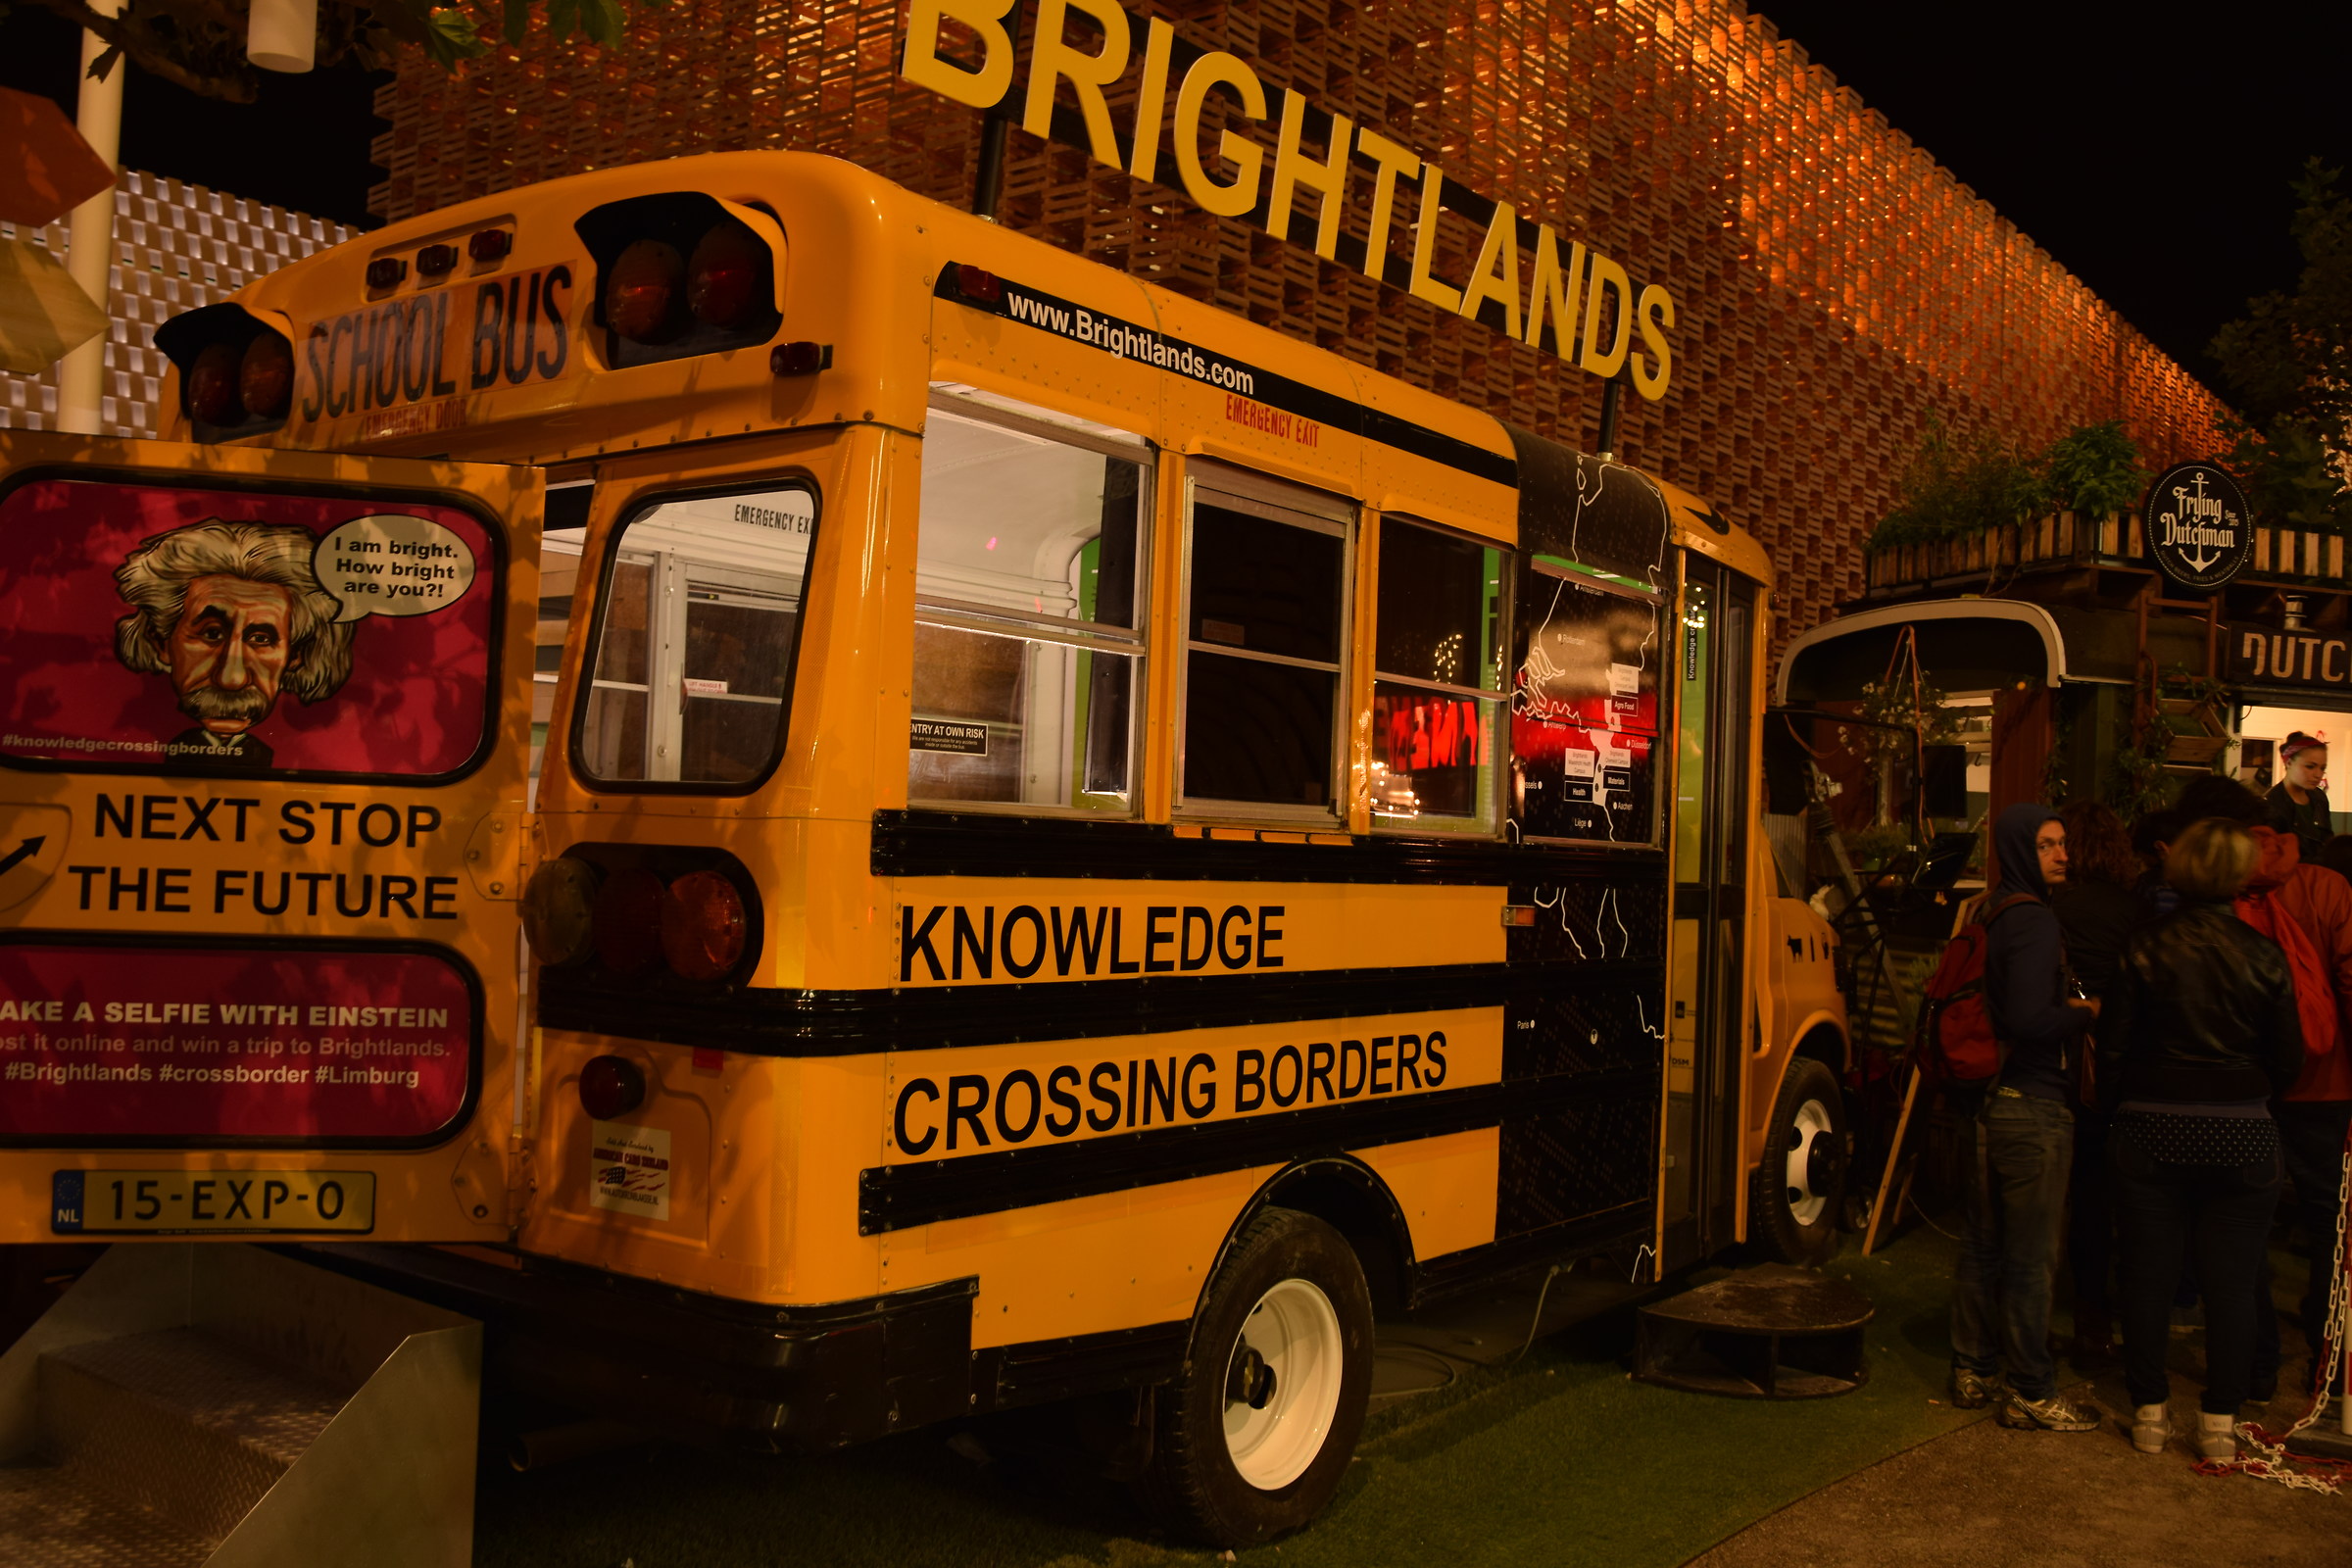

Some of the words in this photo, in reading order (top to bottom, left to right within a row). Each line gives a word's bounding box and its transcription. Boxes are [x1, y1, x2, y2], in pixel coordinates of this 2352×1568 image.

[902, 0, 1675, 401] BRIGHTLANDS
[302, 291, 456, 422] SCHOOL
[471, 265, 571, 389] BUS
[1007, 291, 1253, 396] www.Brightlands.com
[367, 404, 430, 441] EMERGENCY
[436, 398, 467, 429] DOOR
[1226, 394, 1290, 439] EMERGENCY
[1296, 421, 1319, 448] EXIT
[735, 504, 795, 531] EMERGENCY
[2173, 486, 2223, 525] Frying
[335, 536, 342, 551] I
[349, 540, 381, 553] am
[389, 540, 459, 560] bright.
[2160, 512, 2235, 549] Dutchman
[336, 558, 384, 574] How
[391, 562, 455, 581] bright
[344, 581, 379, 594] are
[386, 583, 444, 599] you?!
[1688, 637, 1697, 680] Knowledge
[2242, 632, 2352, 683] DUTC
[2, 734, 243, 757] #knowledgecrossingborders
[909, 722, 933, 735] NTRY
[934, 725, 945, 737] AT
[946, 725, 964, 738] OWN
[965, 727, 985, 740] RISK
[1524, 781, 1538, 790] ssels
[95, 794, 260, 842] NEXT
[278, 801, 442, 848] STOP
[69, 865, 190, 912] THE
[215, 870, 458, 919] FUTURE
[900, 906, 1285, 982] KNOWLEDGE
[0, 1001, 63, 1022] AKE
[73, 1002, 95, 1022] A
[104, 1003, 211, 1024] SELFIE
[220, 1004, 298, 1025] WITH
[309, 1005, 448, 1027] EINSTEIN
[33, 1032, 48, 1051] it
[55, 1034, 125, 1052] online
[132, 1035, 174, 1053] and
[181, 1035, 220, 1053] win
[227, 1040, 239, 1054] a
[247, 1037, 283, 1057] trip
[290, 1038, 312, 1054] to
[318, 1037, 451, 1059] Brightlands.
[5, 1062, 153, 1085] #Brightlands
[158, 1064, 310, 1083] #crossborder
[315, 1066, 419, 1089] #Limburg
[894, 1054, 1216, 1156] CROSSING
[1235, 1031, 1447, 1113] BORDERS
[57, 1209, 78, 1223] NL
[111, 1181, 344, 1220] 15-EXP-0
